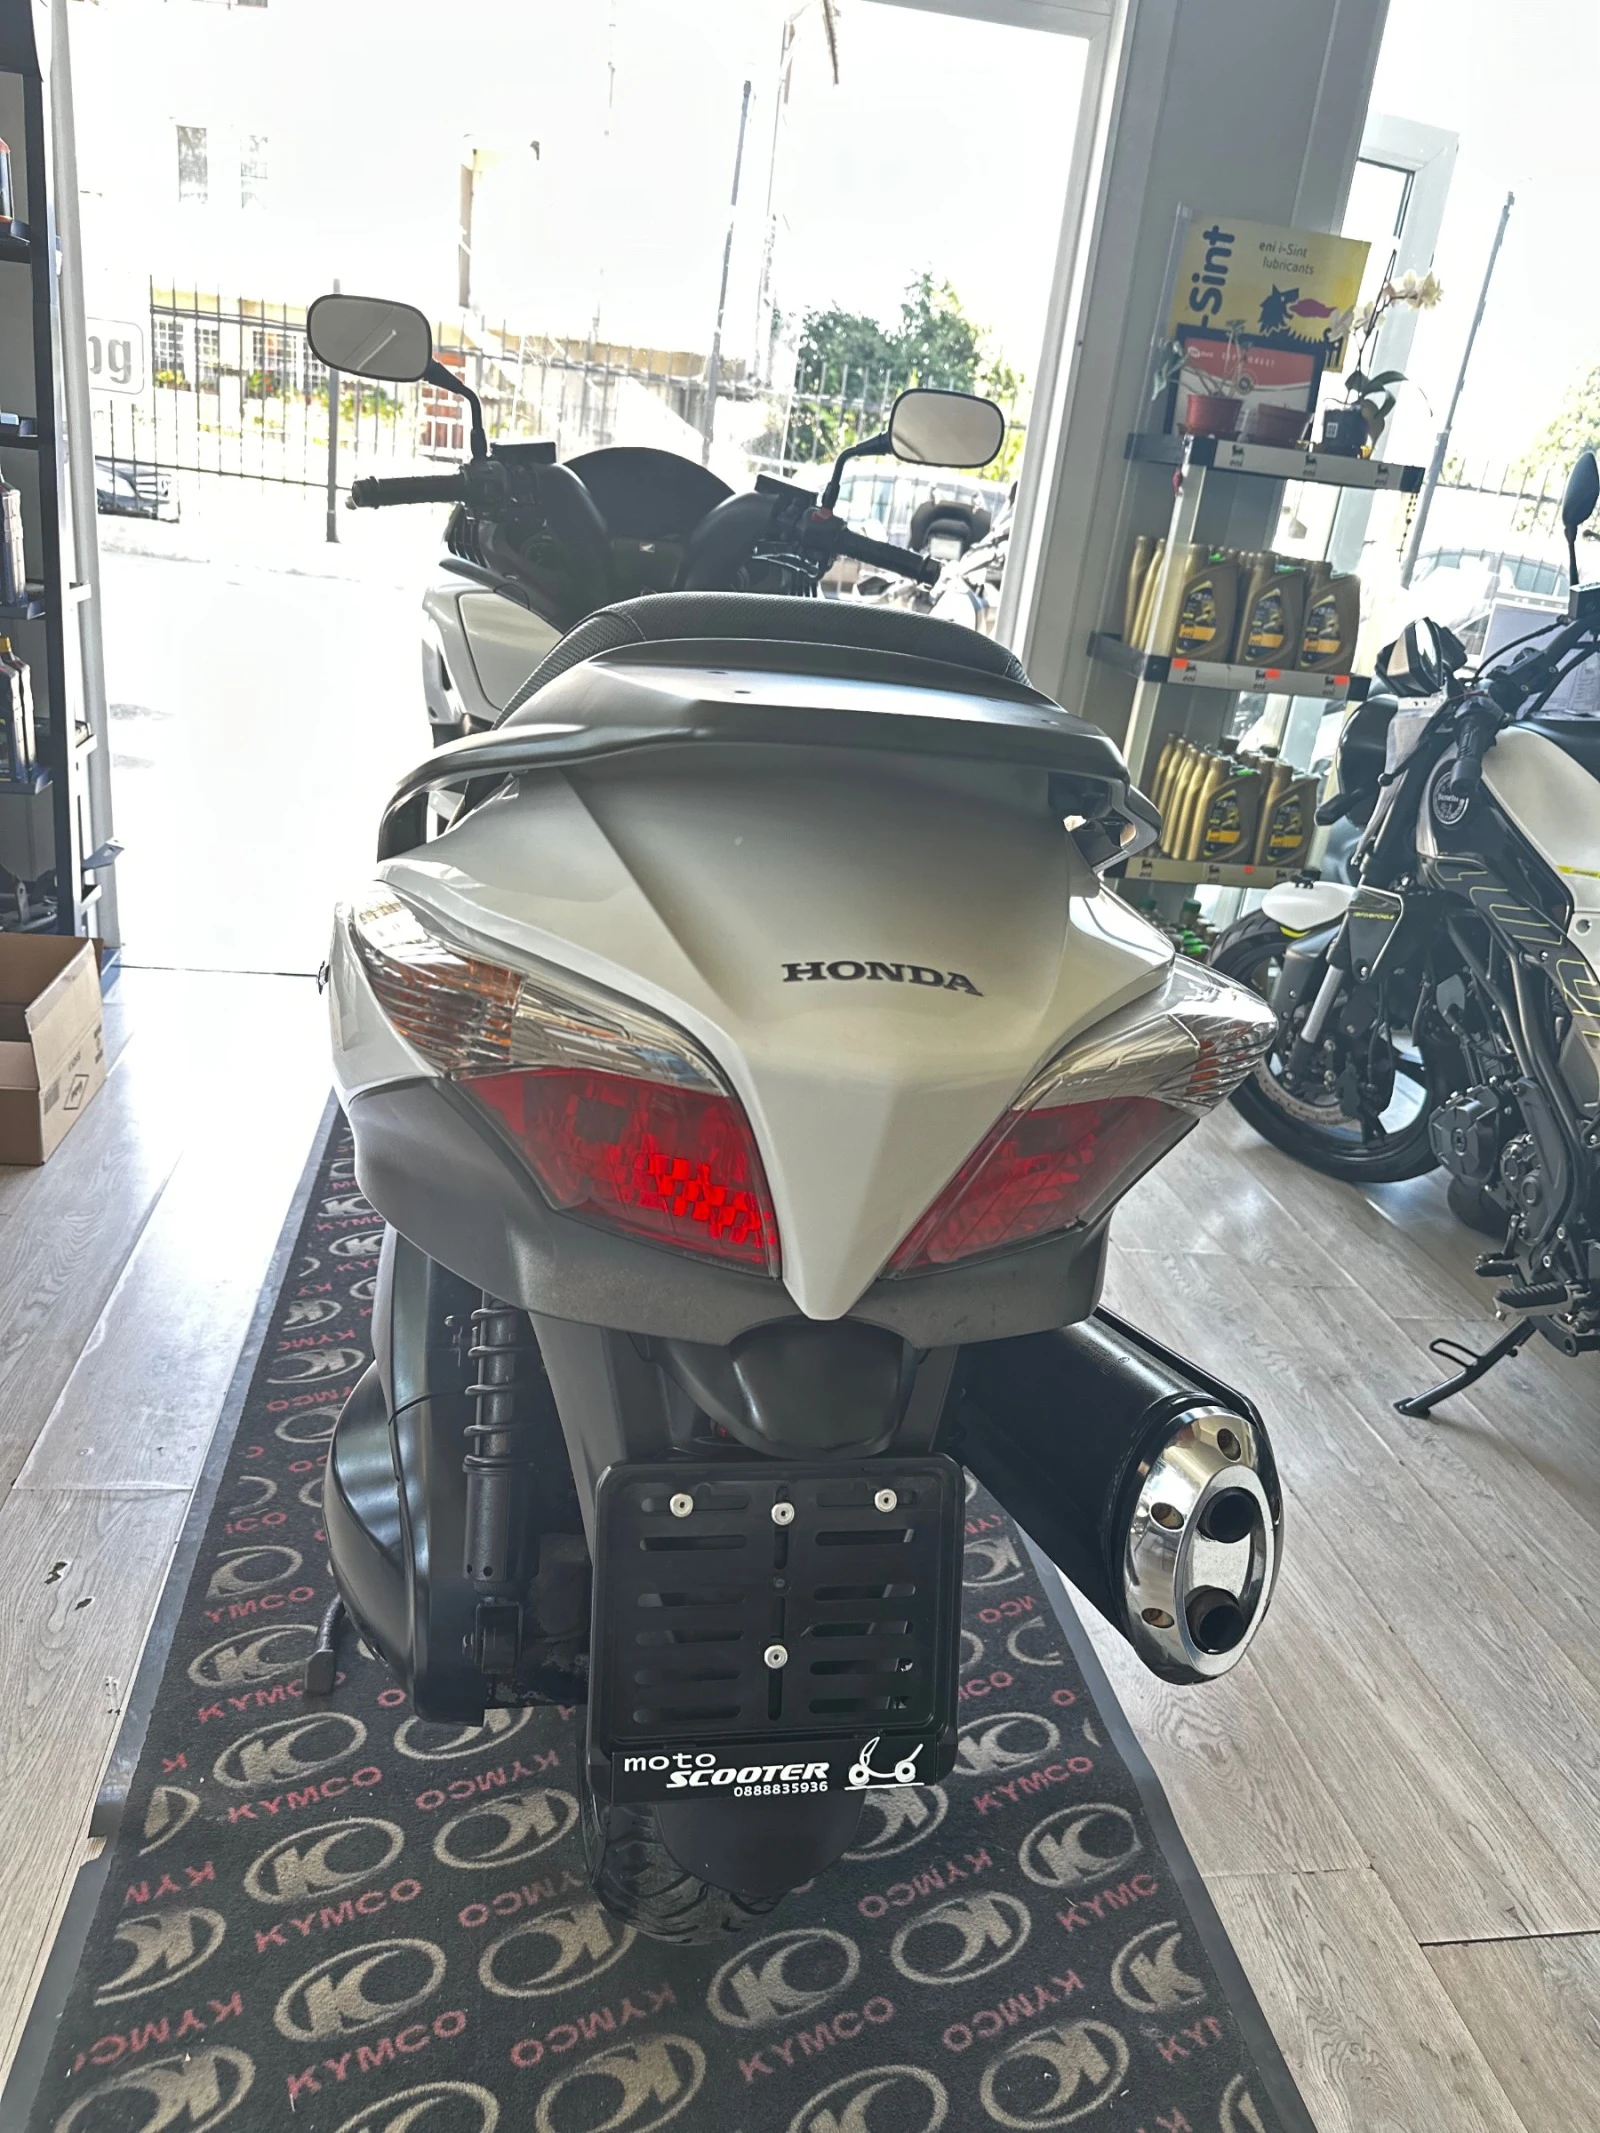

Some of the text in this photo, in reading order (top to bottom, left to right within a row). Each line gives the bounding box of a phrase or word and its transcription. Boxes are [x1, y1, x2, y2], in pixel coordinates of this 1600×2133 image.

[1258, 241, 1308, 259] eni i-Sint
[1262, 259, 1315, 275] lubricants
[781, 960, 985, 997] HONDA
[415, 1749, 561, 1811] KYMCO
[623, 1752, 716, 1773] moto
[665, 1761, 830, 1789] SCOOTER
[733, 1780, 829, 1798] 0888835936
[972, 1756, 1095, 1816] KYMCO
[227, 1766, 383, 1824] KYMCO
[857, 1848, 994, 1919] KYMCO
[1056, 1873, 1160, 1934] KYMC
[254, 1878, 422, 1954] KYMCO
[509, 1981, 678, 2069] KYMCO
[737, 1994, 898, 2084] KYMCO
[941, 1968, 1086, 2053] KYMCO
[285, 2009, 468, 2099] KYMCO
